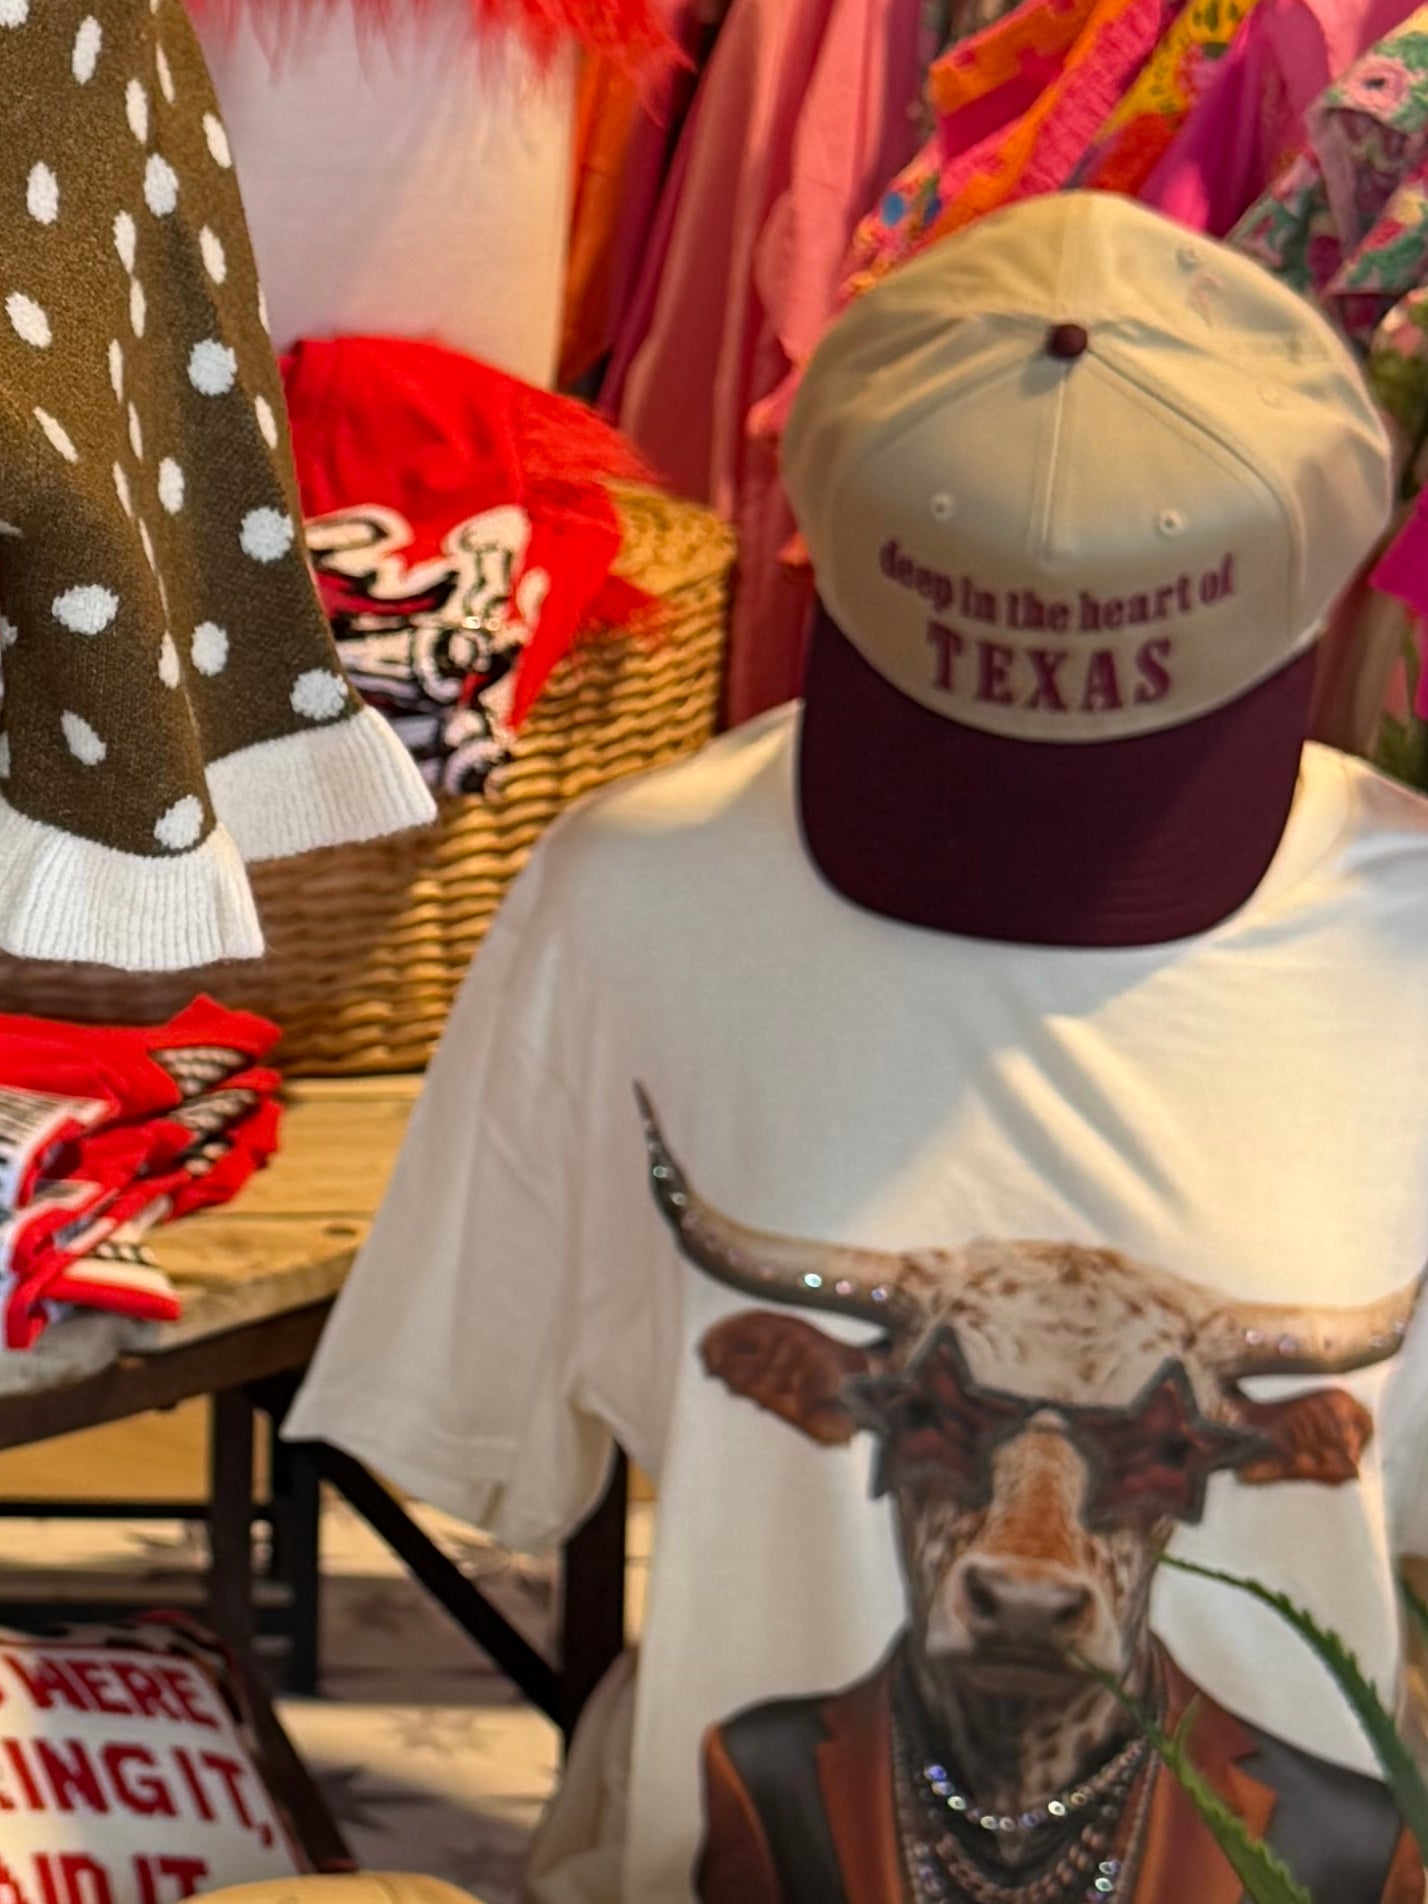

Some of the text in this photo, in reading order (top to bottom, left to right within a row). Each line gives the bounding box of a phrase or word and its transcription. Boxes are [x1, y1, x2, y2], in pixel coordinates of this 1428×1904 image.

[879, 539, 1236, 634] deep in the heart of
[926, 618, 1174, 713] TEXAS
